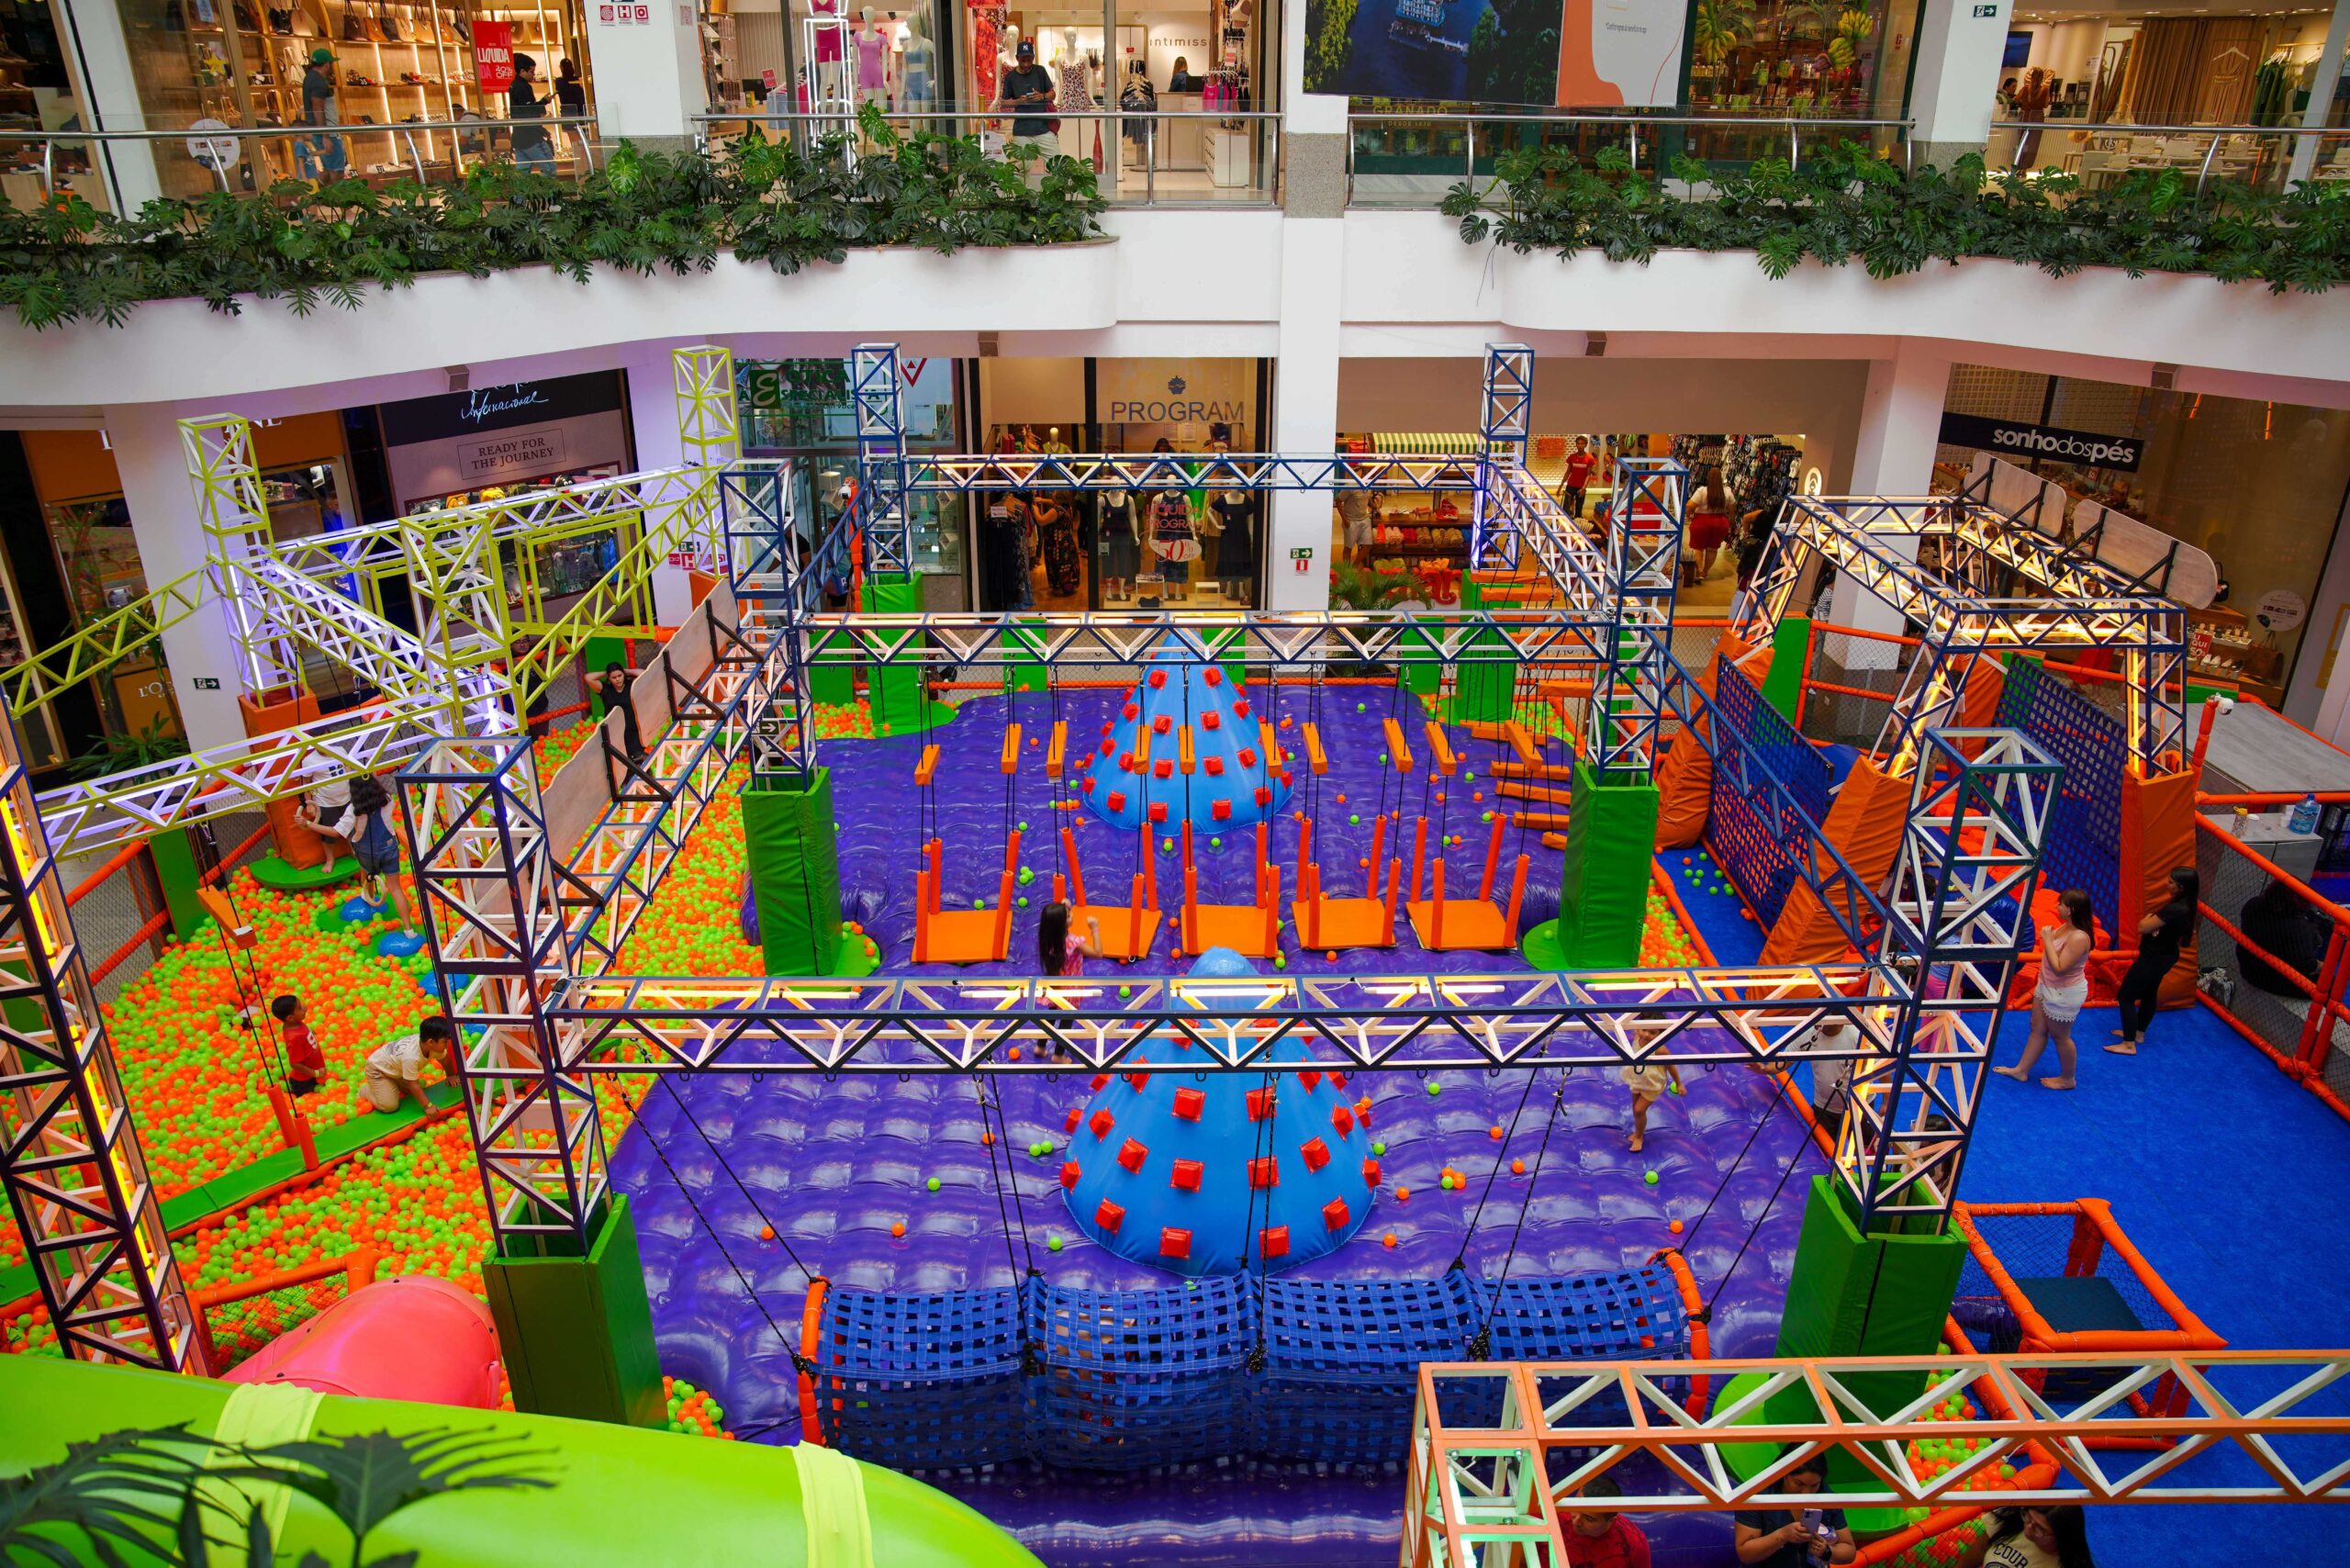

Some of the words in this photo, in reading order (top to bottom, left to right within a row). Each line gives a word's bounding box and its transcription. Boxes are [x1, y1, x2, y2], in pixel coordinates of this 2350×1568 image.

[477, 48, 509, 63] LIQUIDA
[1373, 105, 1448, 115] GRANADO
[780, 388, 879, 401] SPECIALISA
[1112, 401, 1244, 421] PROGRAM
[478, 442, 517, 457] READY
[522, 437, 545, 449] FOR
[1993, 428, 2135, 464] sonhodospés
[472, 459, 497, 470] THE
[499, 447, 554, 466] JOURNEY
[1147, 504, 1201, 515] LIQUIDA
[1147, 520, 1203, 529] PROGRAM
